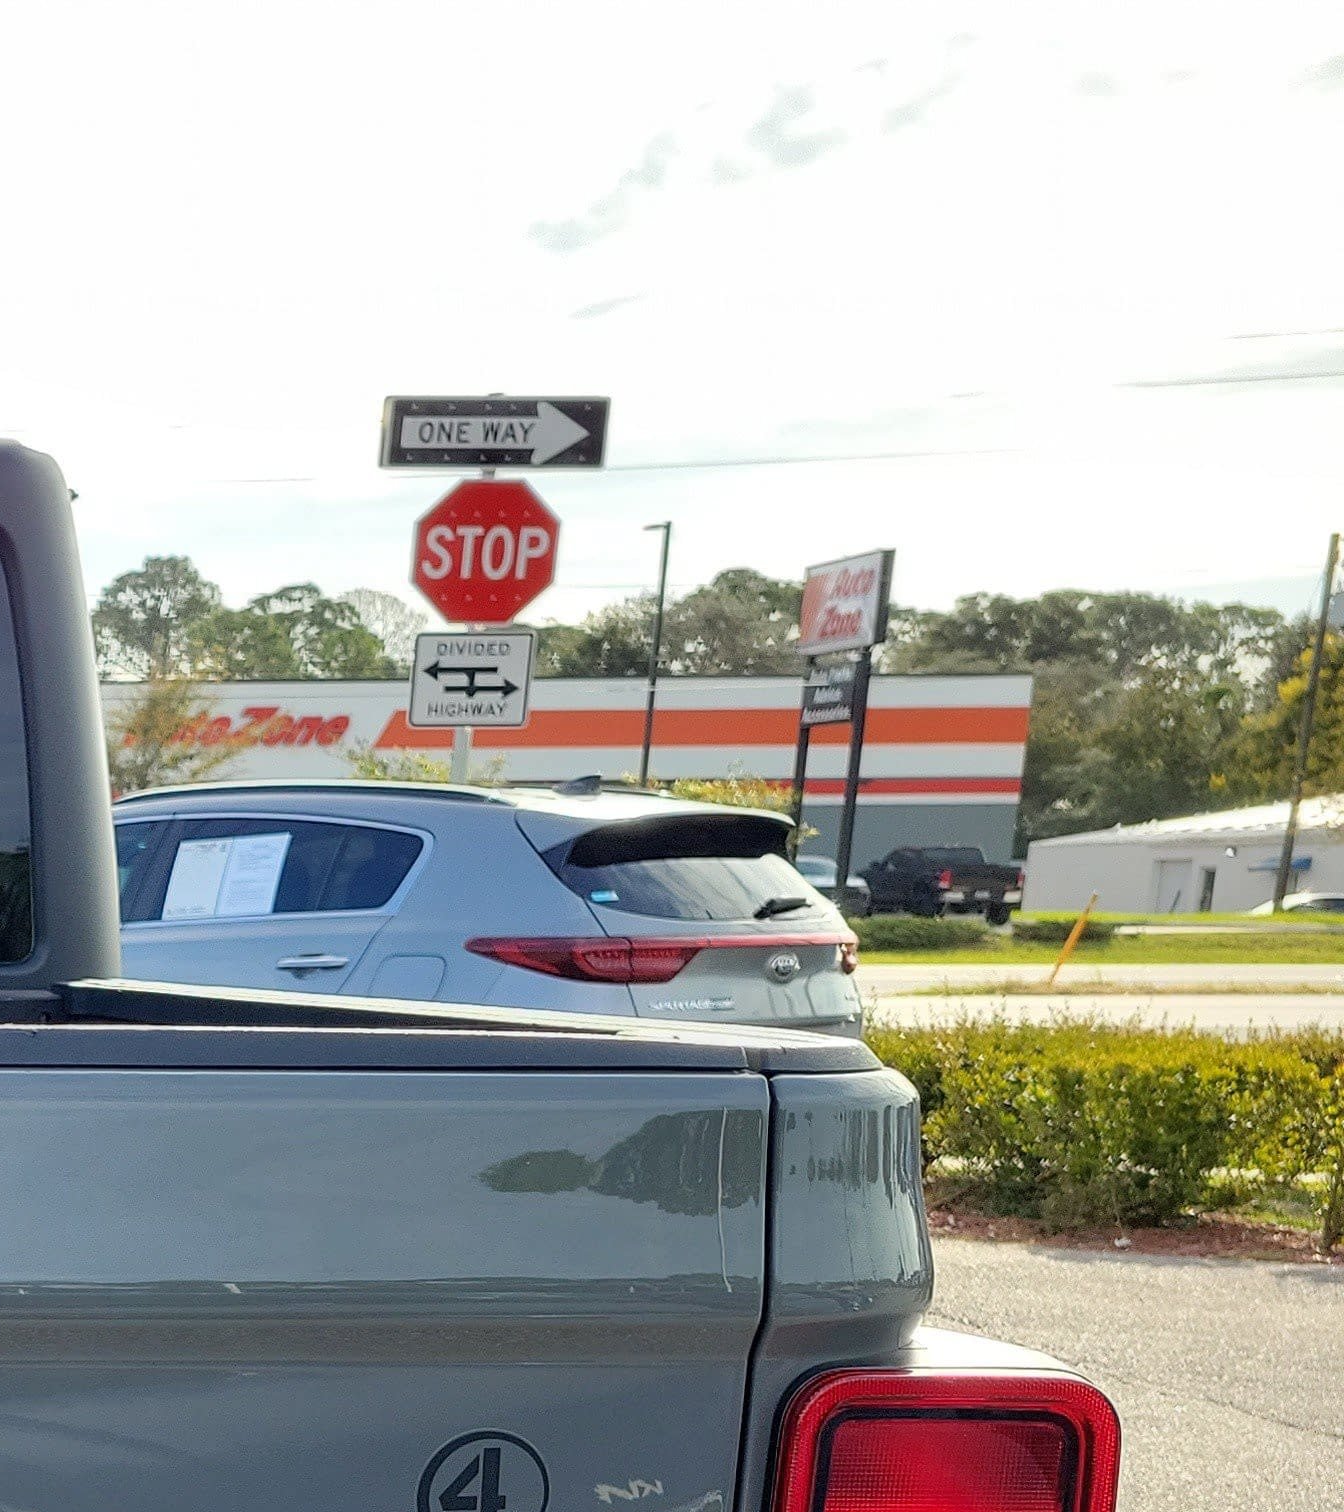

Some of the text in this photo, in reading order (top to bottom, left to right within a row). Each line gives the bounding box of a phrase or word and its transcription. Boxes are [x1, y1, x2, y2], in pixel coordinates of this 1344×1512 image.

[418, 421, 537, 444] ONE WAY
[420, 524, 551, 581] STOP
[817, 603, 862, 639] Zone
[436, 641, 511, 657] DIVIDED
[426, 702, 509, 718] HIGHWAY
